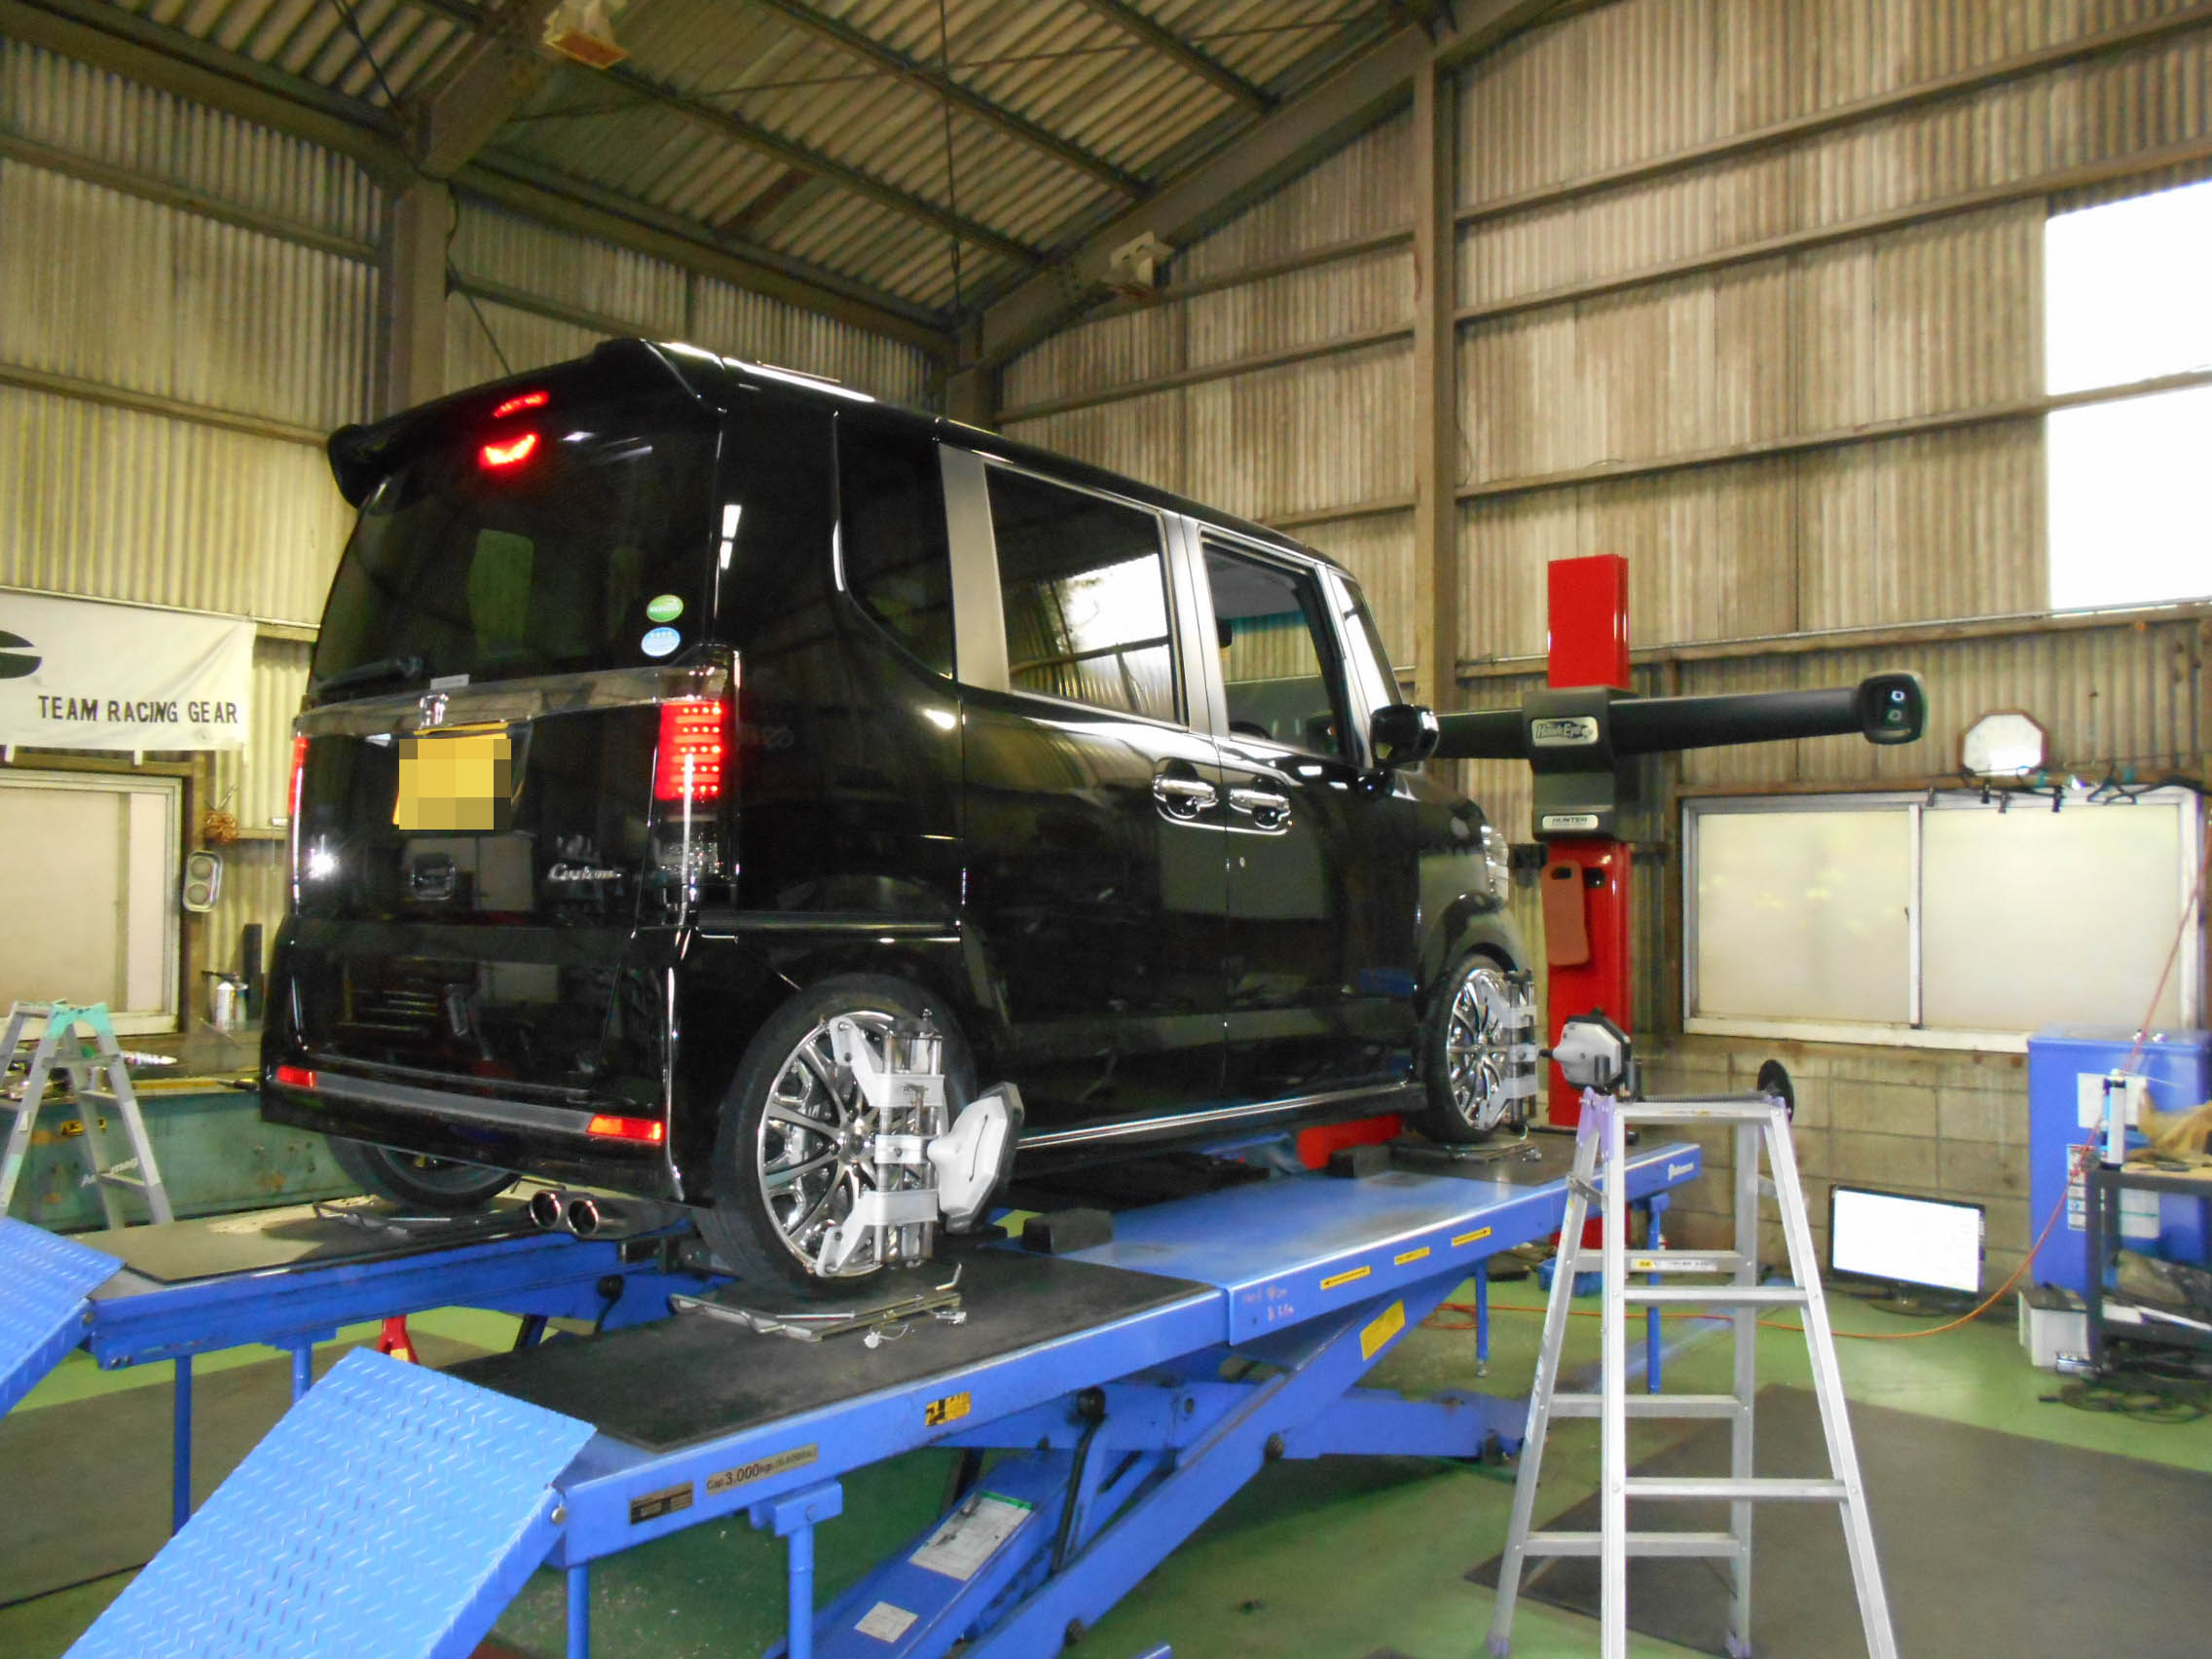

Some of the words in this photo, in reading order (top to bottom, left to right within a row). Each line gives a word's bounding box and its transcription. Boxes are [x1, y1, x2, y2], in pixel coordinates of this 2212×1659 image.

[38, 695, 98, 722] TEAM
[107, 700, 179, 723] RACING
[188, 701, 238, 723] GEAR
